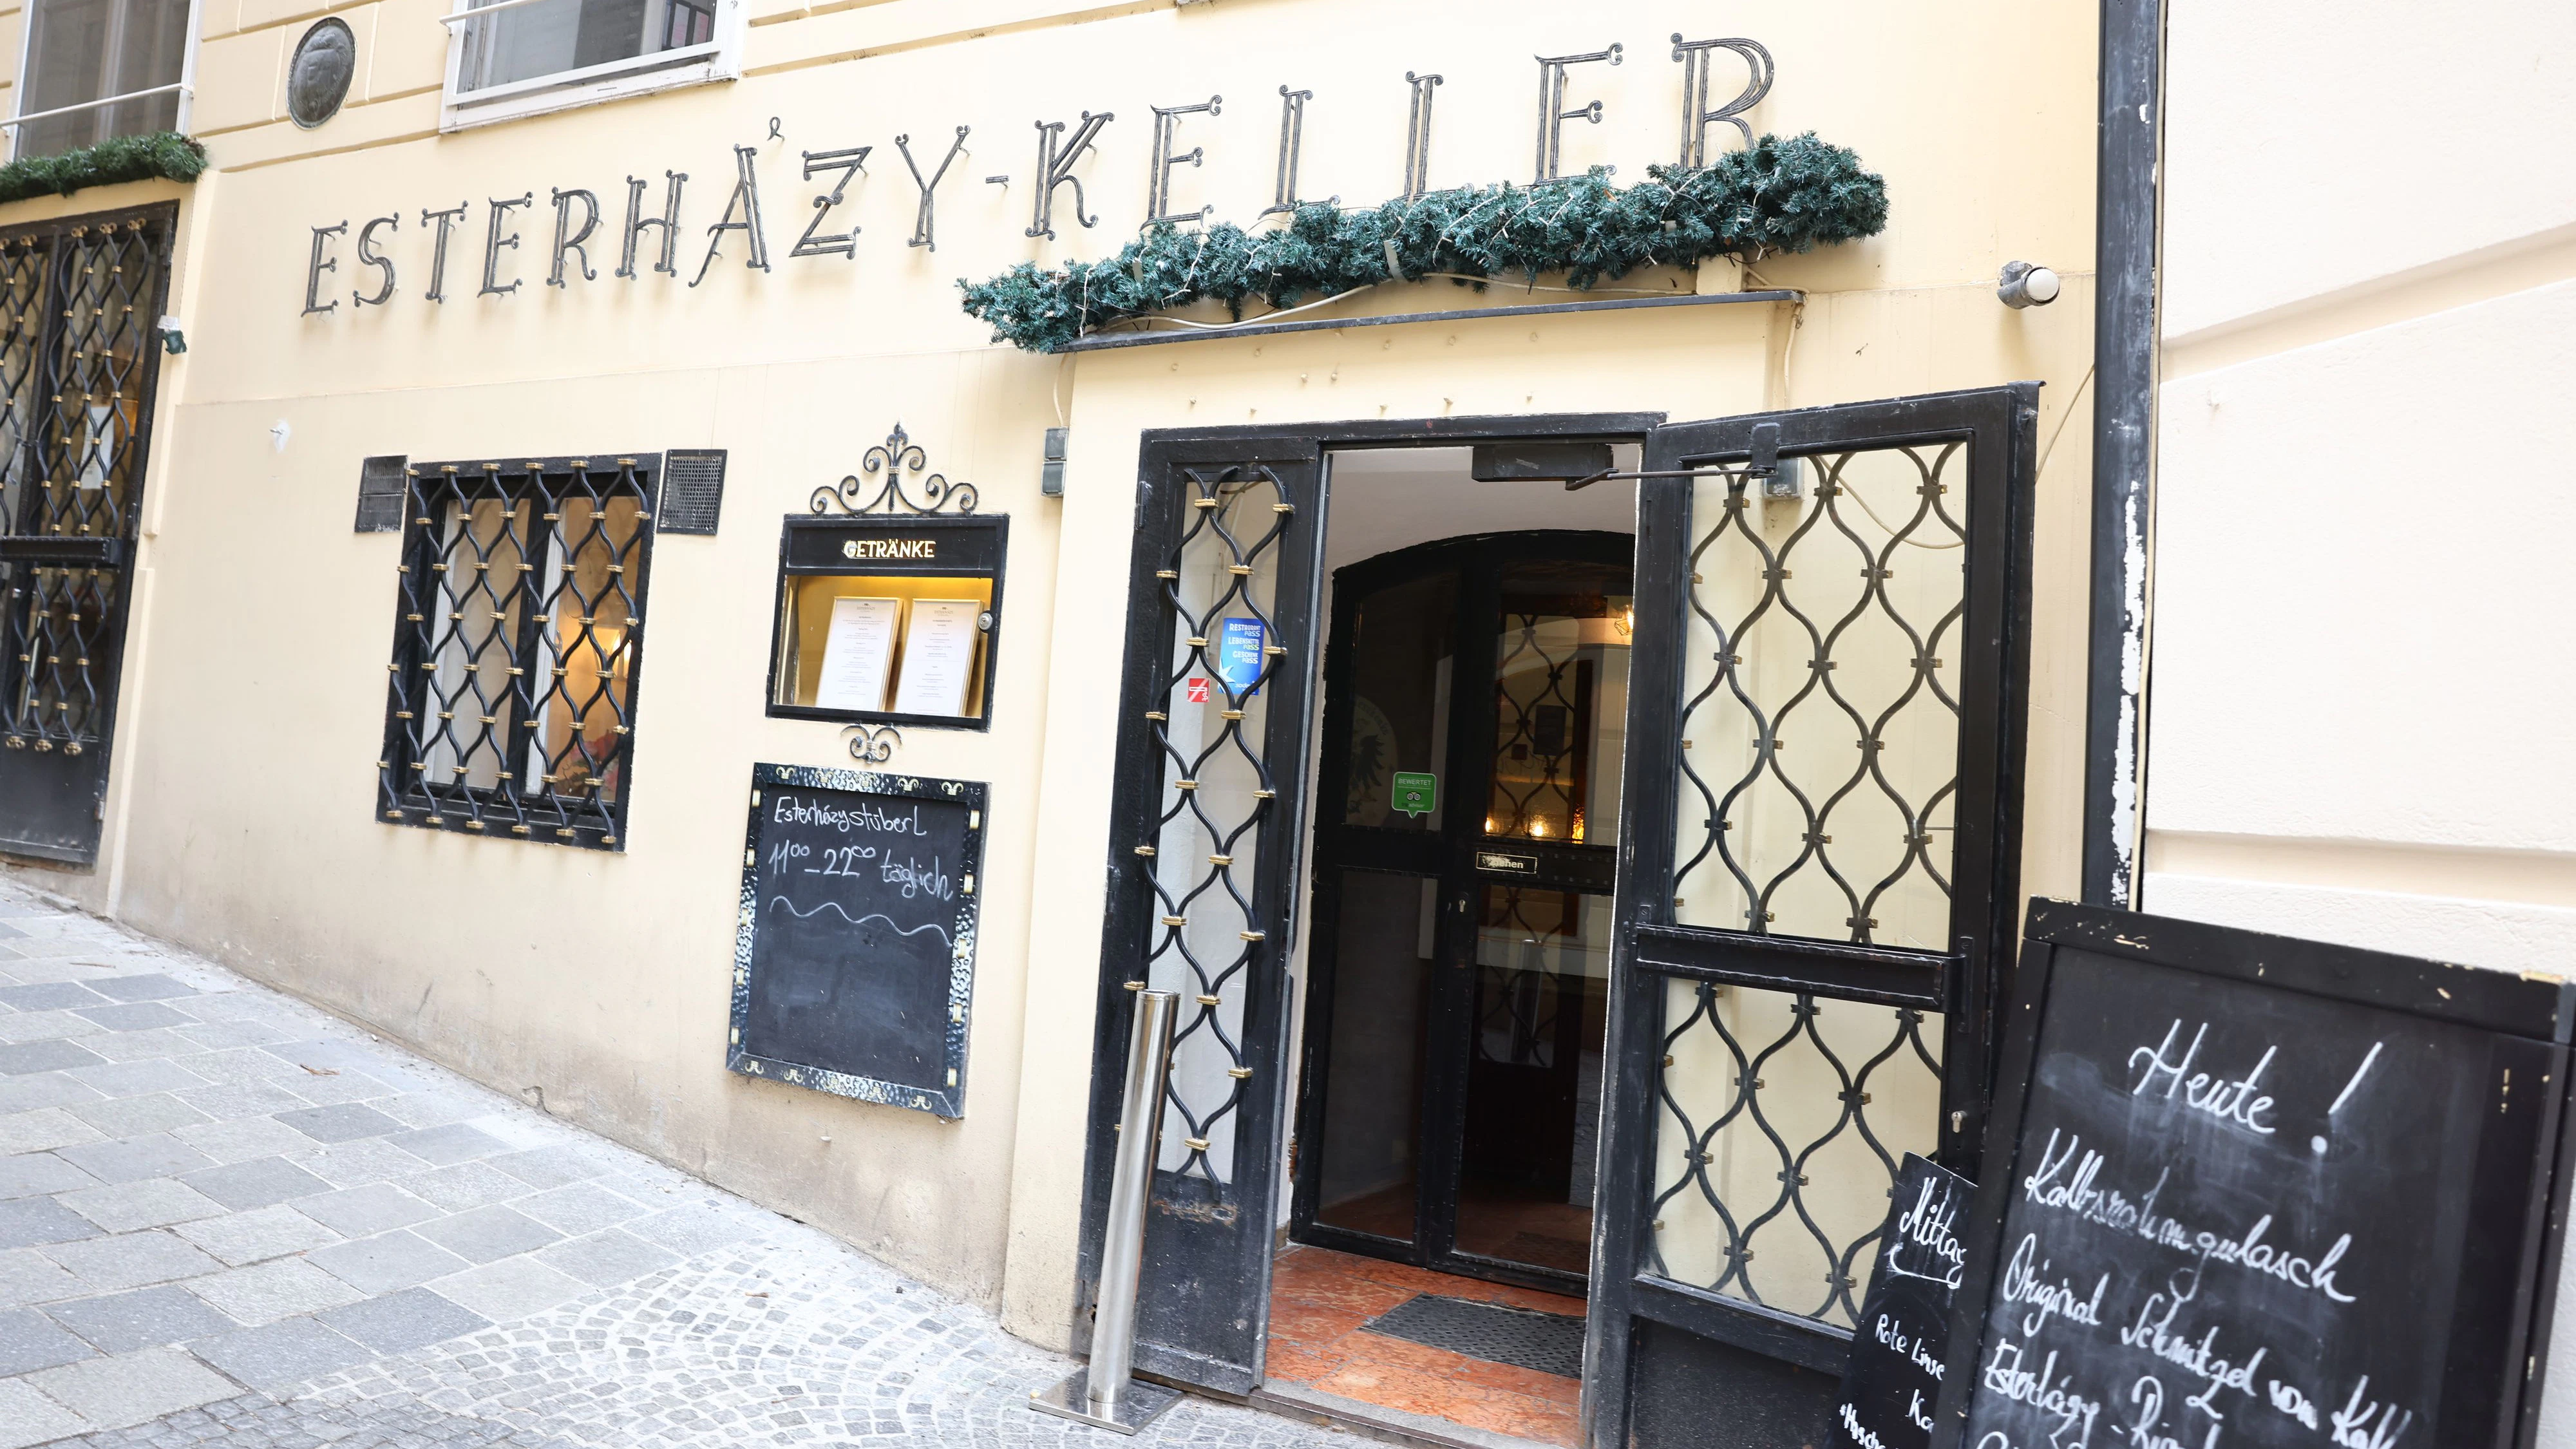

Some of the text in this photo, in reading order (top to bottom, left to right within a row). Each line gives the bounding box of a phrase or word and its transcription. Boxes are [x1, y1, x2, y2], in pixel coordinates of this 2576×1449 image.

[844, 538, 936, 558] GETRÄNKE
[1229, 623, 1261, 631] RESTAURANT
[880, 849, 953, 902] täglich
[2128, 1019, 2276, 1134] Heute
[2003, 1233, 2111, 1338] Original
[1875, 1313, 1907, 1353] Rote
